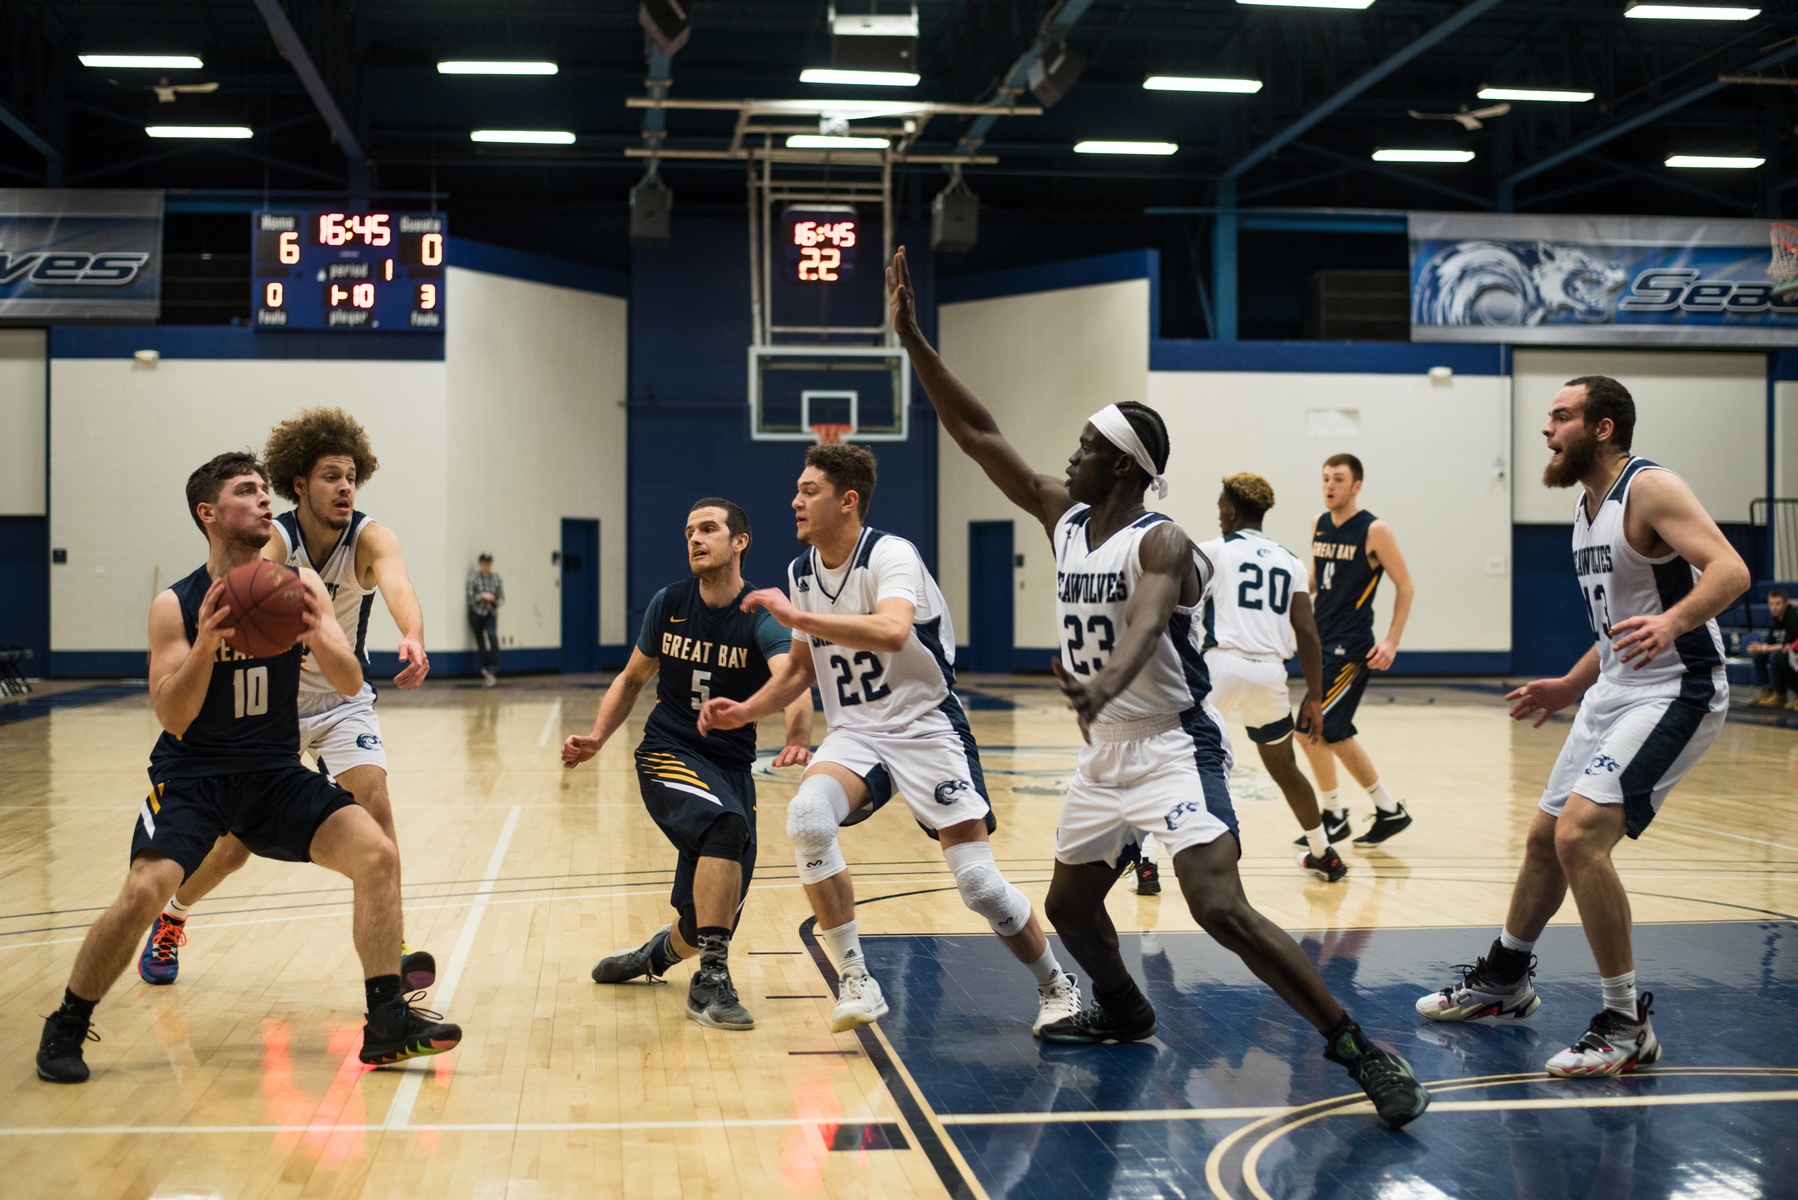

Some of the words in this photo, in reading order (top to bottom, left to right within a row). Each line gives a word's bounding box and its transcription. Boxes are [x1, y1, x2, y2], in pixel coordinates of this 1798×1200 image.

[320, 213, 391, 246] 16:45
[794, 221, 856, 247] 16:45
[279, 231, 300, 264] 6
[421, 233, 443, 266] 0
[798, 247, 841, 281] 22
[0, 251, 150, 286] ves
[385, 258, 393, 281] 1
[266, 282, 283, 307] 0
[420, 283, 436, 309] 3
[1238, 562, 1291, 615] 20
[661, 632, 714, 664] GREAT
[717, 643, 749, 669] BAY
[1063, 614, 1117, 676] 23
[233, 665, 268, 719] 10
[690, 669, 712, 711] 5
[830, 651, 892, 707] 22
